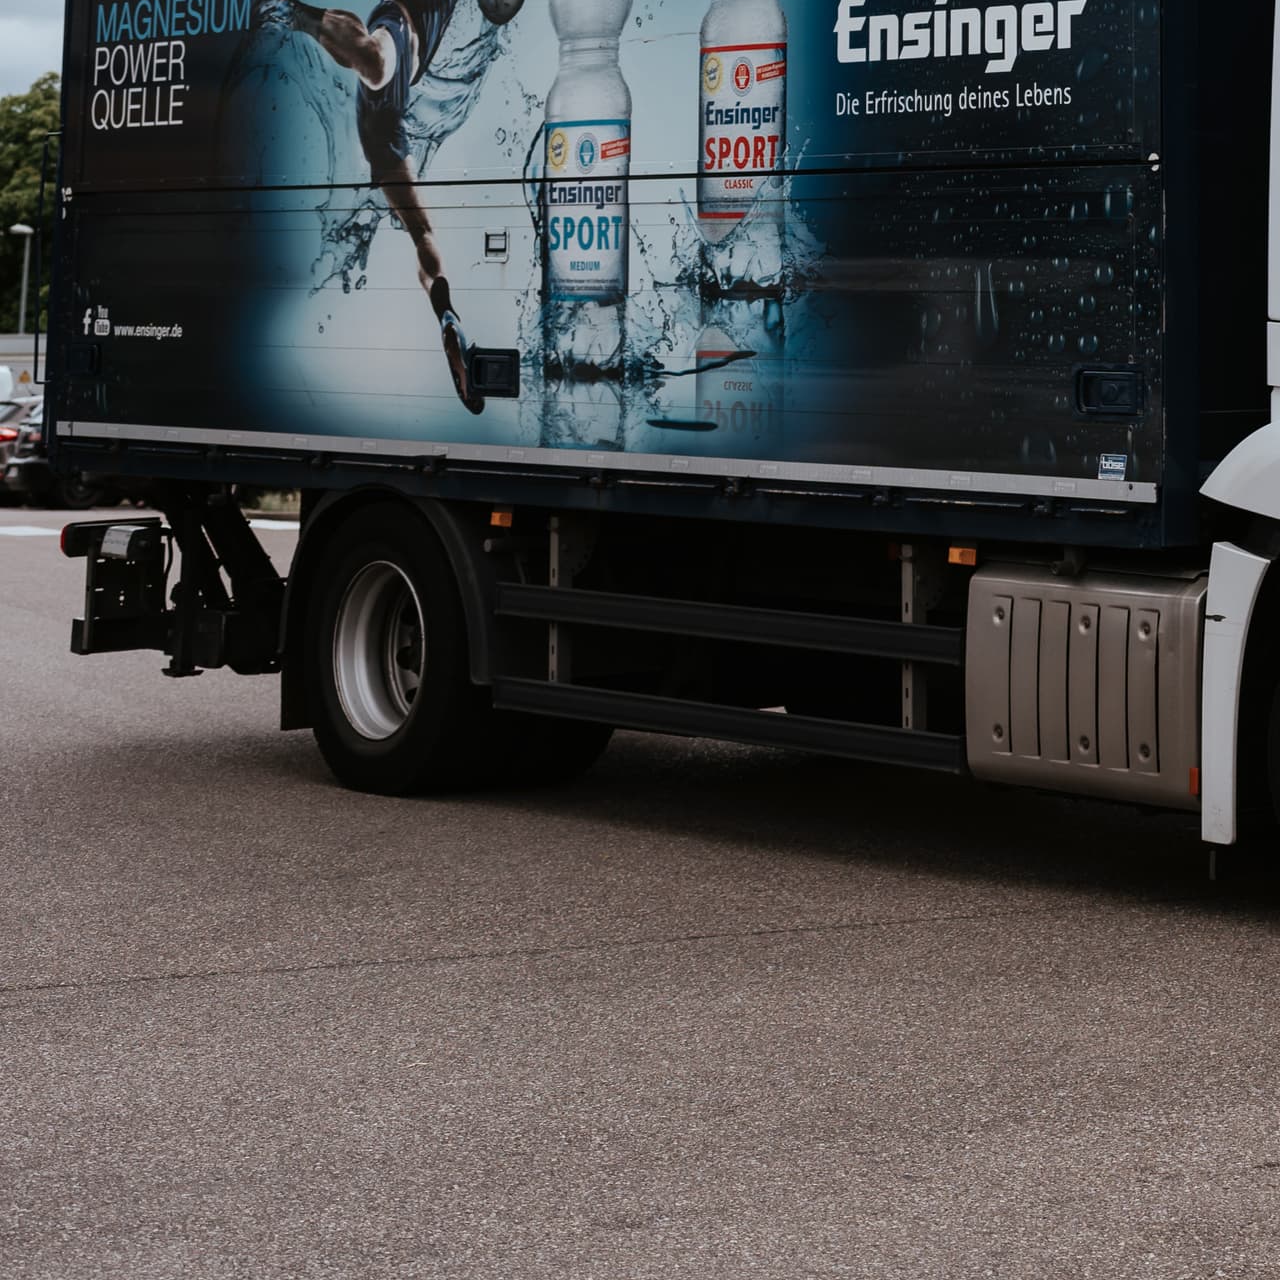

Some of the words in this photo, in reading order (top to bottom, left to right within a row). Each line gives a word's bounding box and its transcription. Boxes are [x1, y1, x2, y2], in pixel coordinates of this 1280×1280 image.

[94, 40, 186, 86] POWER
[836, 92, 860, 116] Die
[865, 89, 952, 117] Erfrischung
[959, 85, 1009, 110] deines
[1016, 82, 1072, 107] Lebens
[705, 101, 780, 130] Ensinger
[704, 135, 779, 170] SPORT
[549, 181, 622, 210] Ensinger
[724, 179, 753, 189] CLASSIC
[549, 216, 623, 250] SPORT
[570, 261, 600, 271] MEDIUM
[114, 323, 183, 340] www.ensinger.de
